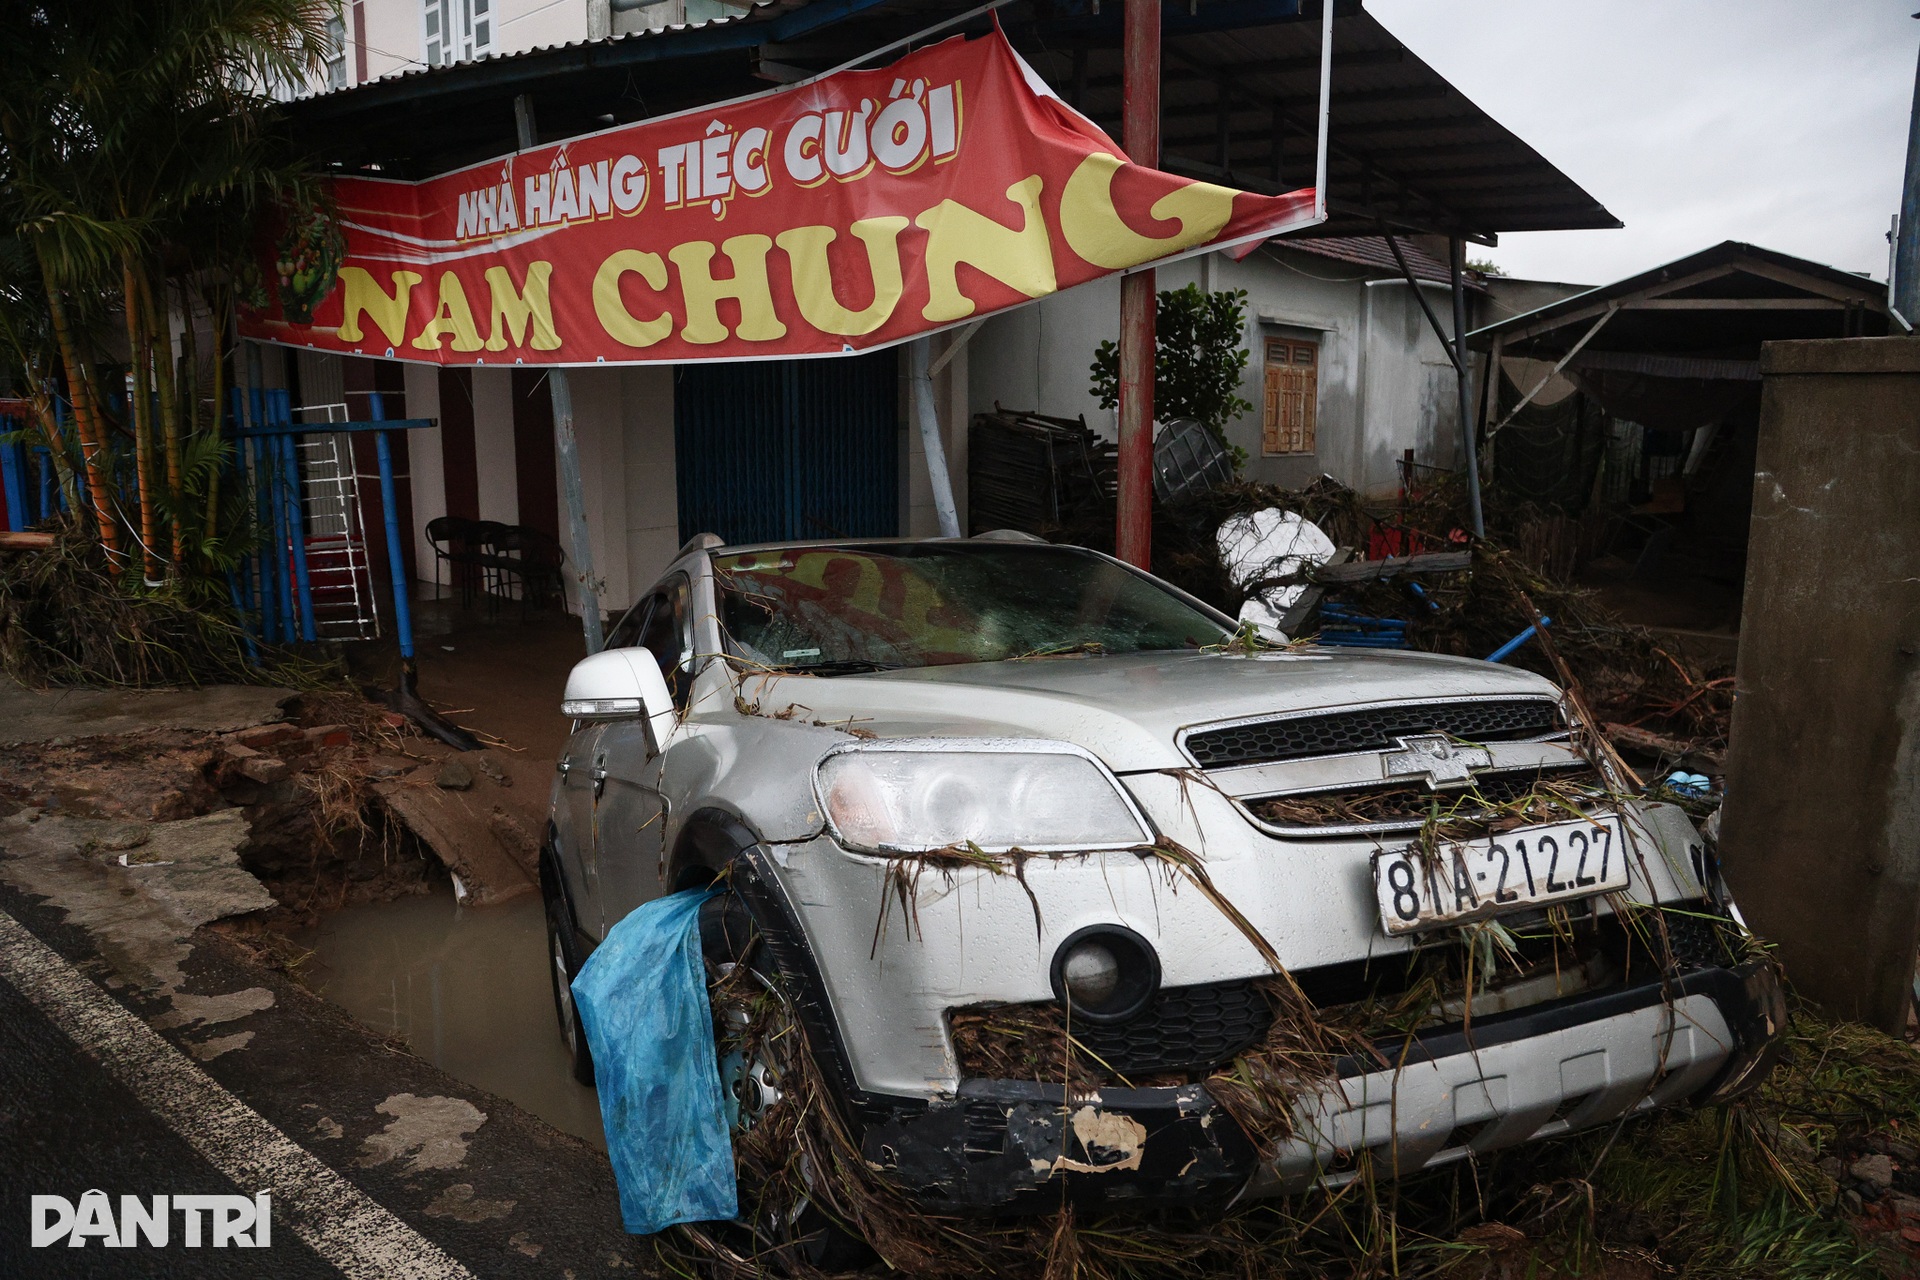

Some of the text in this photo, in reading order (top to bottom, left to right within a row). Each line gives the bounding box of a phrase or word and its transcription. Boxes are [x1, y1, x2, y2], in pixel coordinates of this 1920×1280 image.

[658, 118, 773, 221] TIỆC
[784, 77, 963, 189] CƯỚI
[336, 152, 1243, 352] NAM CHUNG
[1388, 823, 1612, 921] 81A-212.27
